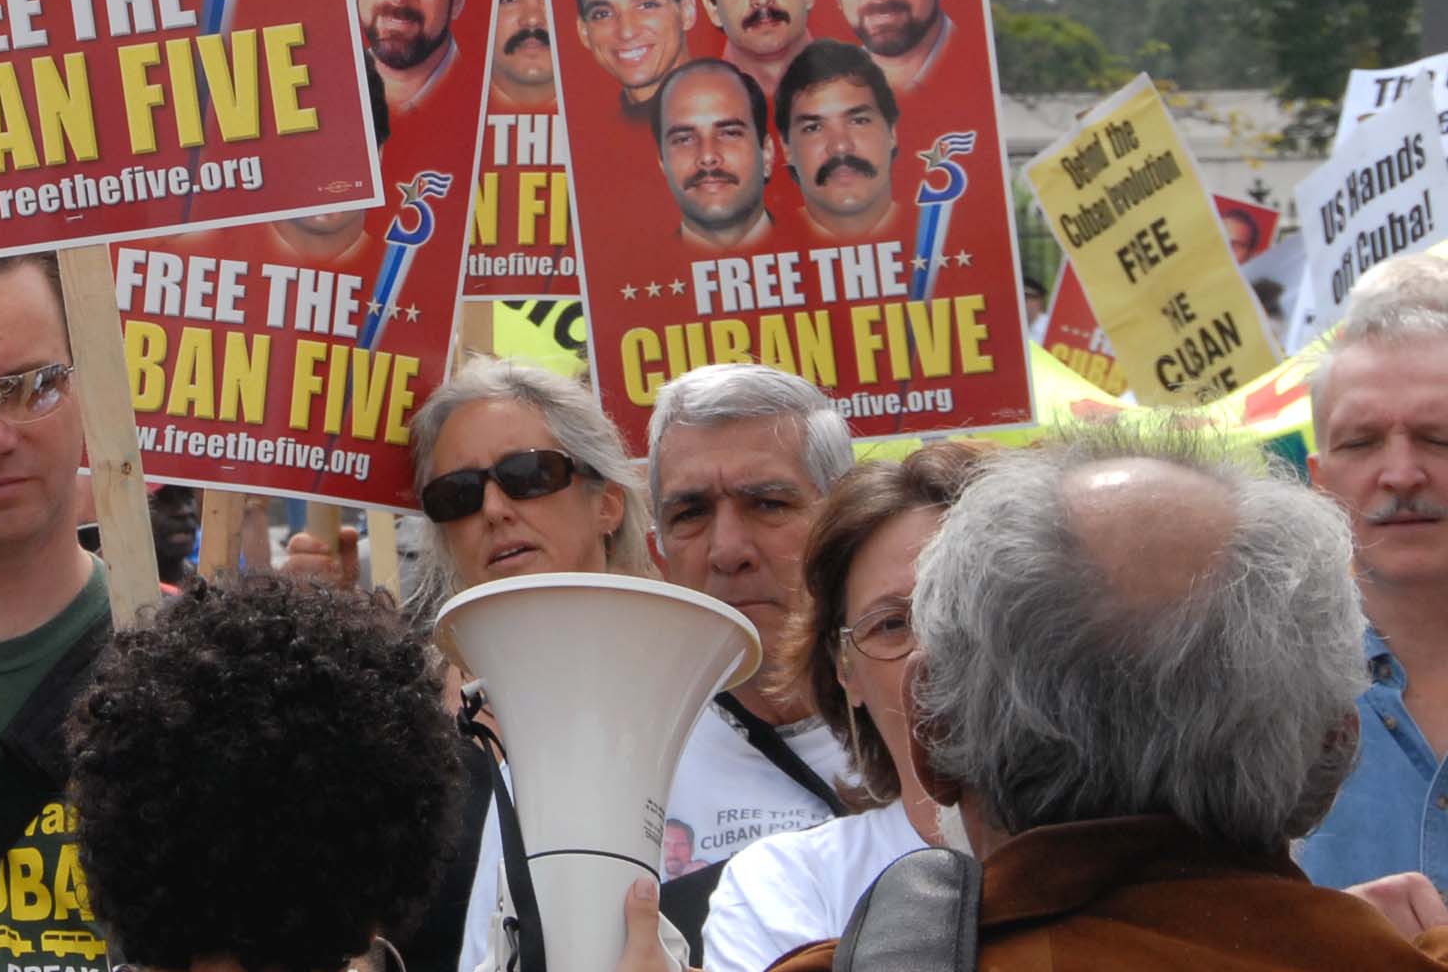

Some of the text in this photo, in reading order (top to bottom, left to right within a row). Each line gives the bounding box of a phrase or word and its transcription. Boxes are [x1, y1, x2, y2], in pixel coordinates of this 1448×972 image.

[118, 23, 319, 154] FIVE
[1105, 120, 1140, 160] the
[1347, 133, 1427, 218] Hands
[518, 172, 569, 245] FI
[1059, 197, 1116, 249] Cuban
[1356, 189, 1435, 275] Cuba!
[116, 247, 363, 339] FREE THE
[464, 253, 581, 277] thefive.o
[691, 241, 907, 315] FREE THE
[123, 320, 420, 446] BAN FIVE
[620, 309, 838, 408] CUBAN
[851, 294, 995, 385] FIVE
[135, 425, 370, 480] w.freethefive.org
[701, 824, 762, 850] CUBAN
[717, 807, 762, 826] FREE
[769, 808, 808, 820] THE
